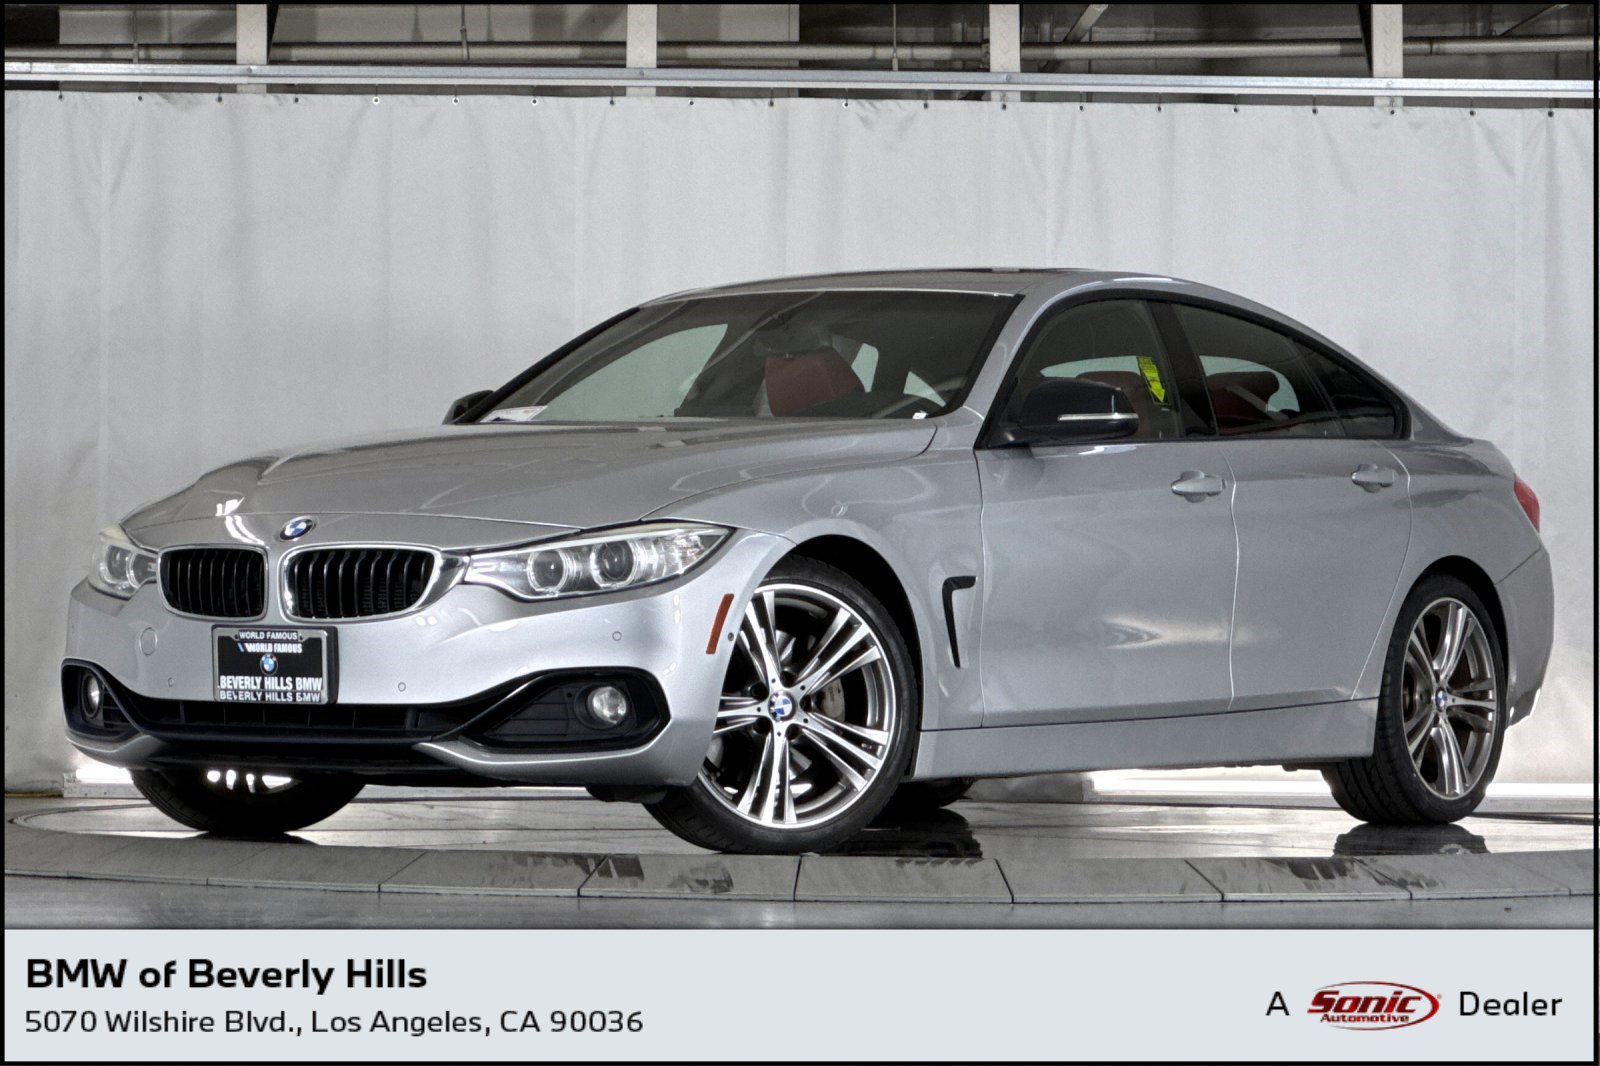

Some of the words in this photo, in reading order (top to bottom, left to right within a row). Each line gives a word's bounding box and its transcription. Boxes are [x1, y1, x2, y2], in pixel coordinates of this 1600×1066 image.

[240, 632, 265, 640] WORLD
[267, 632, 298, 640] FAMOUS
[247, 643, 273, 653] WORLD
[274, 643, 303, 653] FAMOUS
[220, 675, 262, 690] BEVERLY
[264, 676, 293, 690] HILLS
[296, 677, 322, 691] BMW
[220, 690, 262, 701] BEVERLY
[265, 691, 293, 701] HILLS
[296, 692, 321, 702] BMW
